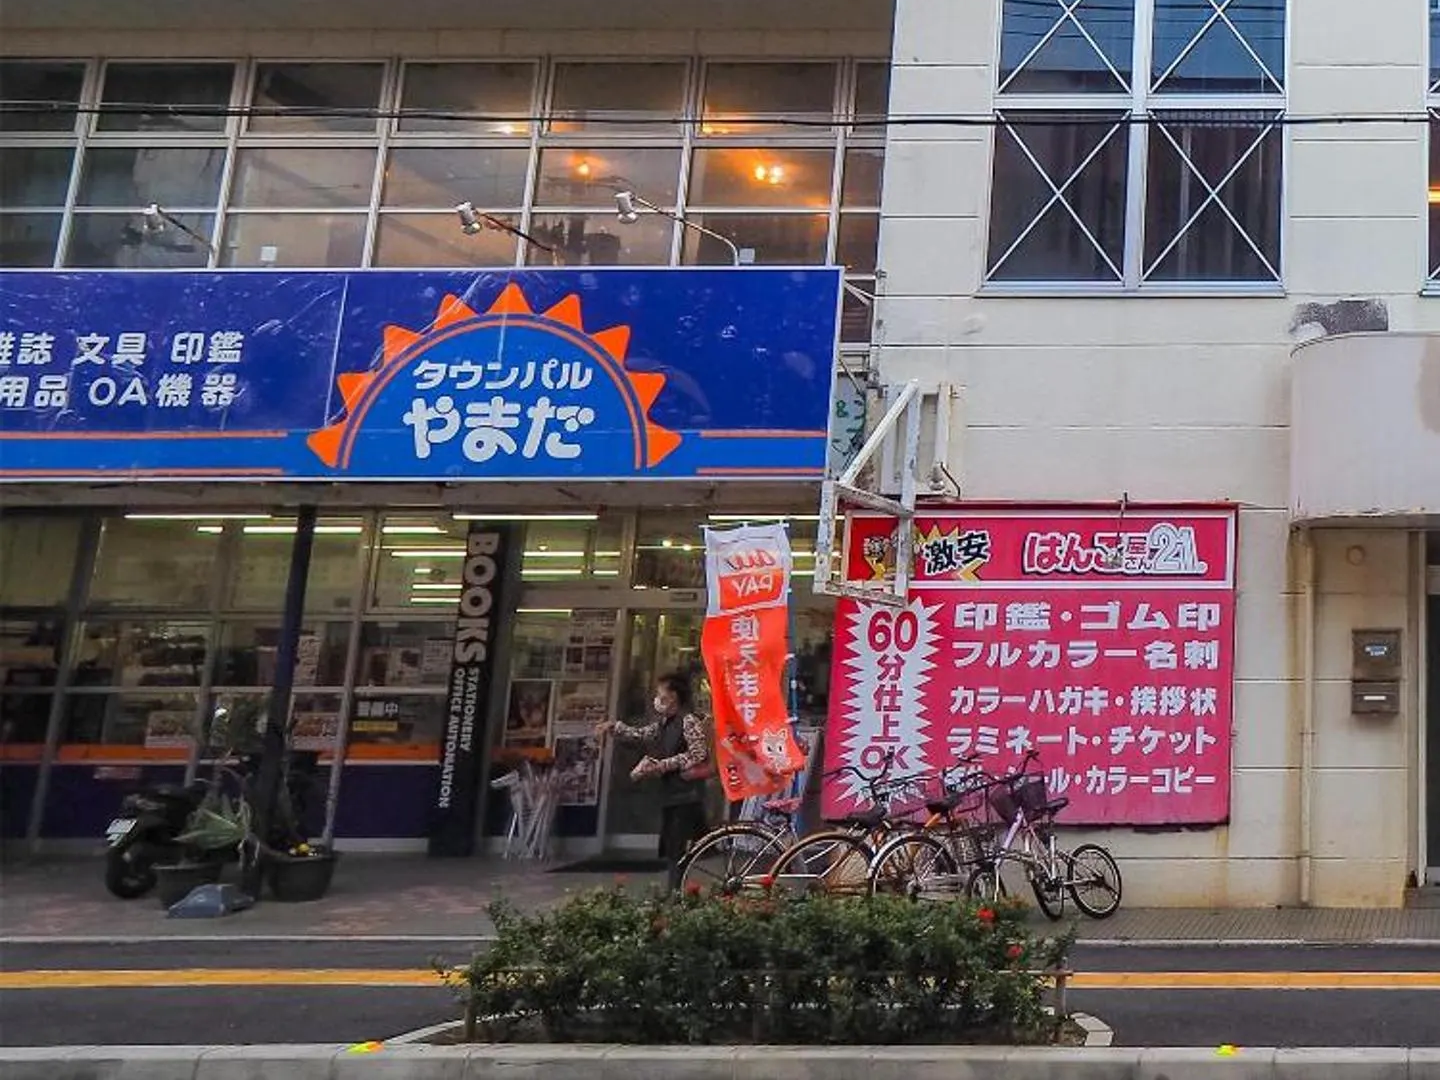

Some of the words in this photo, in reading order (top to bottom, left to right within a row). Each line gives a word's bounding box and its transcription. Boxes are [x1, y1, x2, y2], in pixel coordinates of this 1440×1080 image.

[72, 332, 147, 365] 文具
[171, 331, 244, 364] 印鑑
[0, 375, 68, 407] 用品
[88, 373, 238, 407] OA機器
[412, 358, 593, 390] タウンパル
[402, 395, 595, 463] やまだ
[924, 530, 991, 576] 激安
[455, 532, 500, 663] BOOKS
[953, 602, 1221, 631] 印鑑・ゴム印
[951, 640, 1219, 670] フルカラー名刺
[451, 668, 466, 711] OFFICE
[949, 686, 1217, 716] カラーハガキ・挨拶状
[460, 667, 480, 751] STATIONERY
[946, 725, 1217, 756] ラミネート・チケット
[438, 715, 459, 809] AUTOMATION
